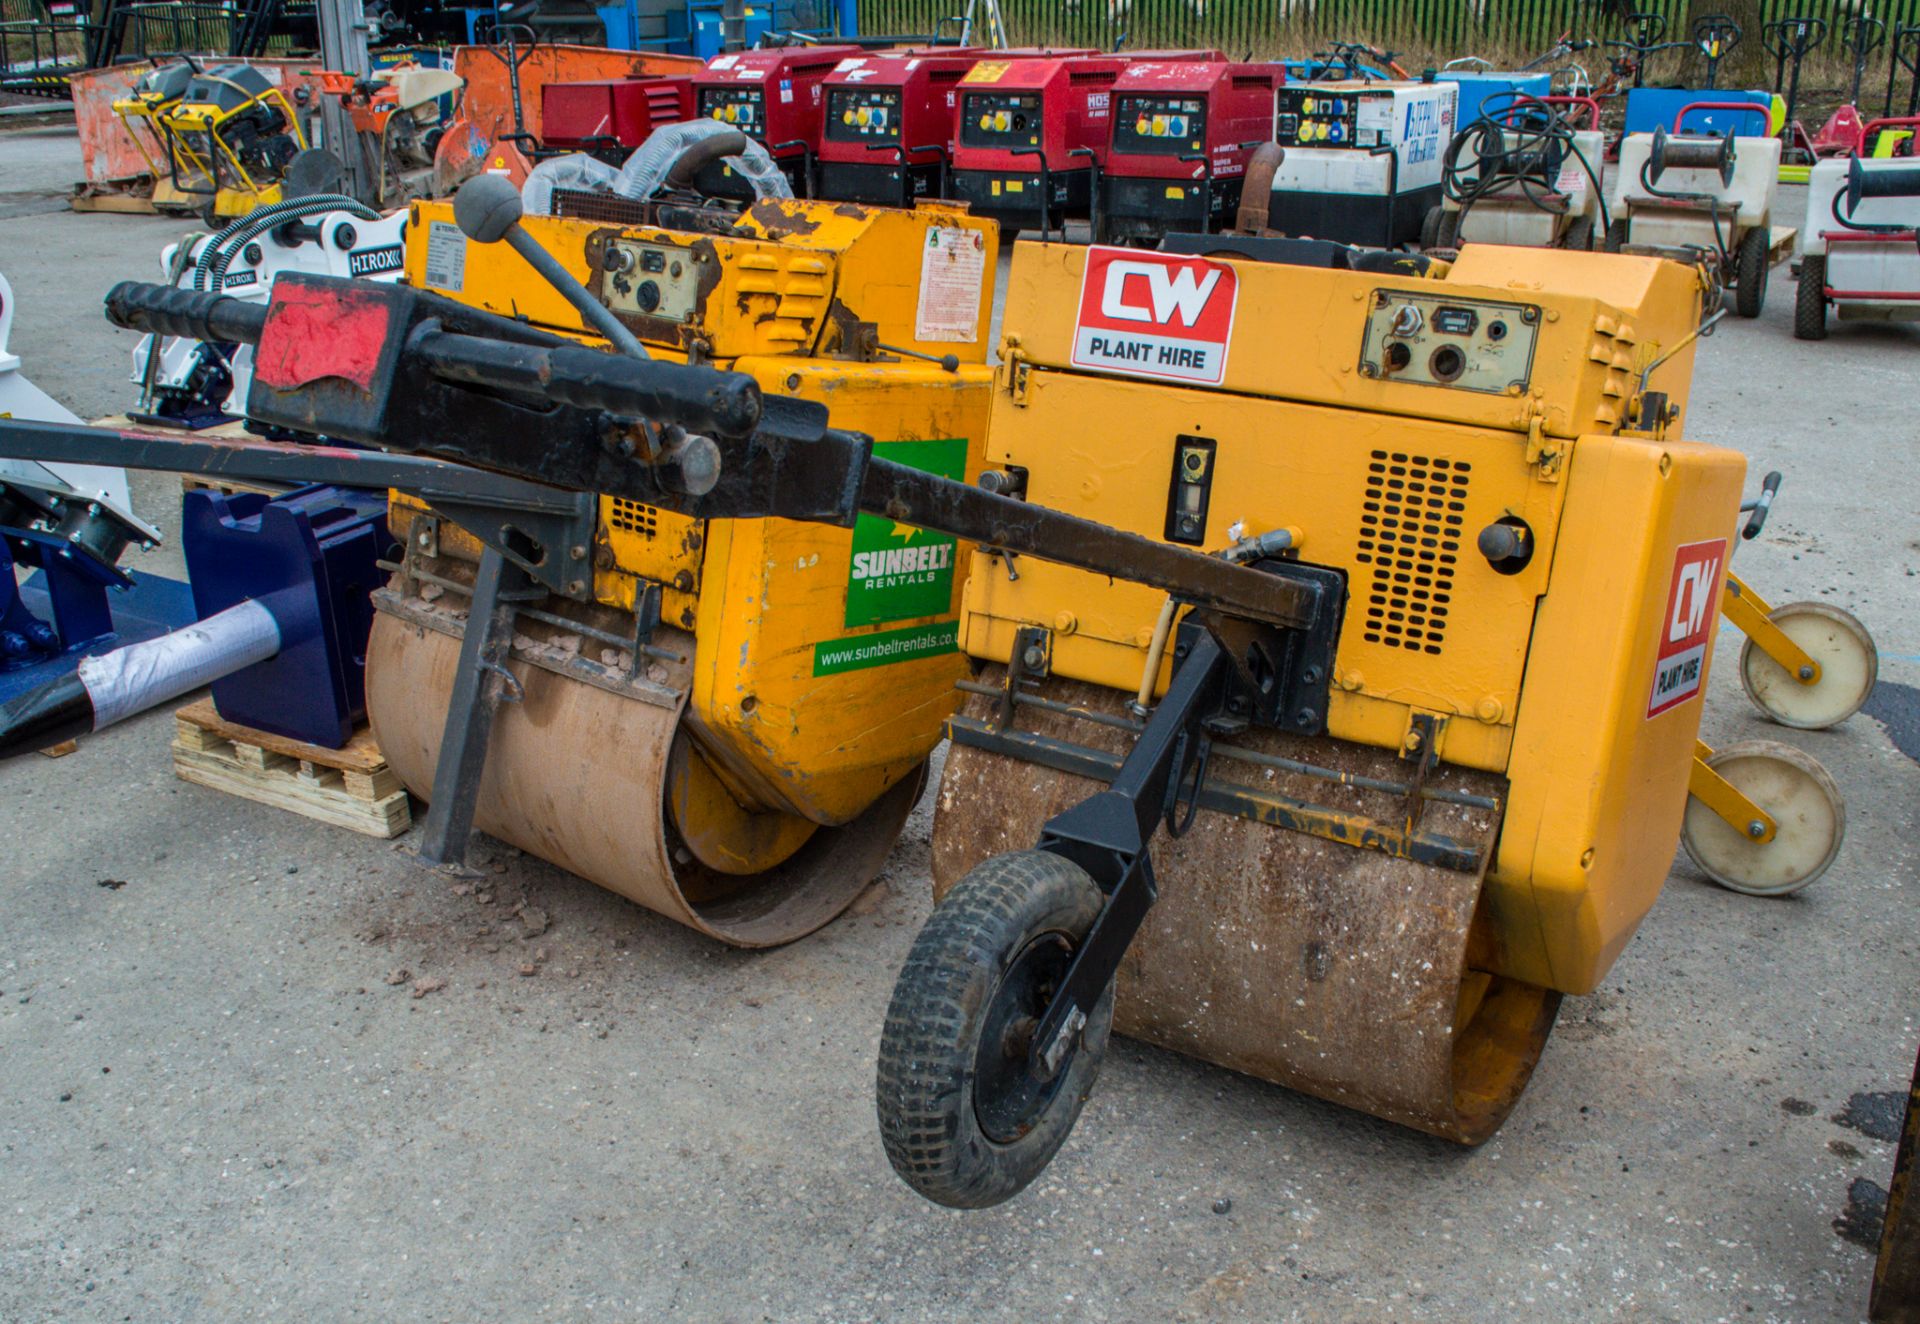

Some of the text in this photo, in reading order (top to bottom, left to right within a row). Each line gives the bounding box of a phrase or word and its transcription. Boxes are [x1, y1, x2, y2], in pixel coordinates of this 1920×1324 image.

[1088, 94, 1110, 107] MOS
[351, 250, 393, 272] HIROX
[226, 275, 251, 286] HIROX
[1101, 259, 1223, 328] CW
[1089, 337, 1206, 369] PLANT HIRE
[852, 543, 952, 580] SUNBELT
[865, 571, 936, 590] RENTALS
[1669, 557, 1719, 643] CW
[1657, 657, 1700, 696] PLANT HIRE
